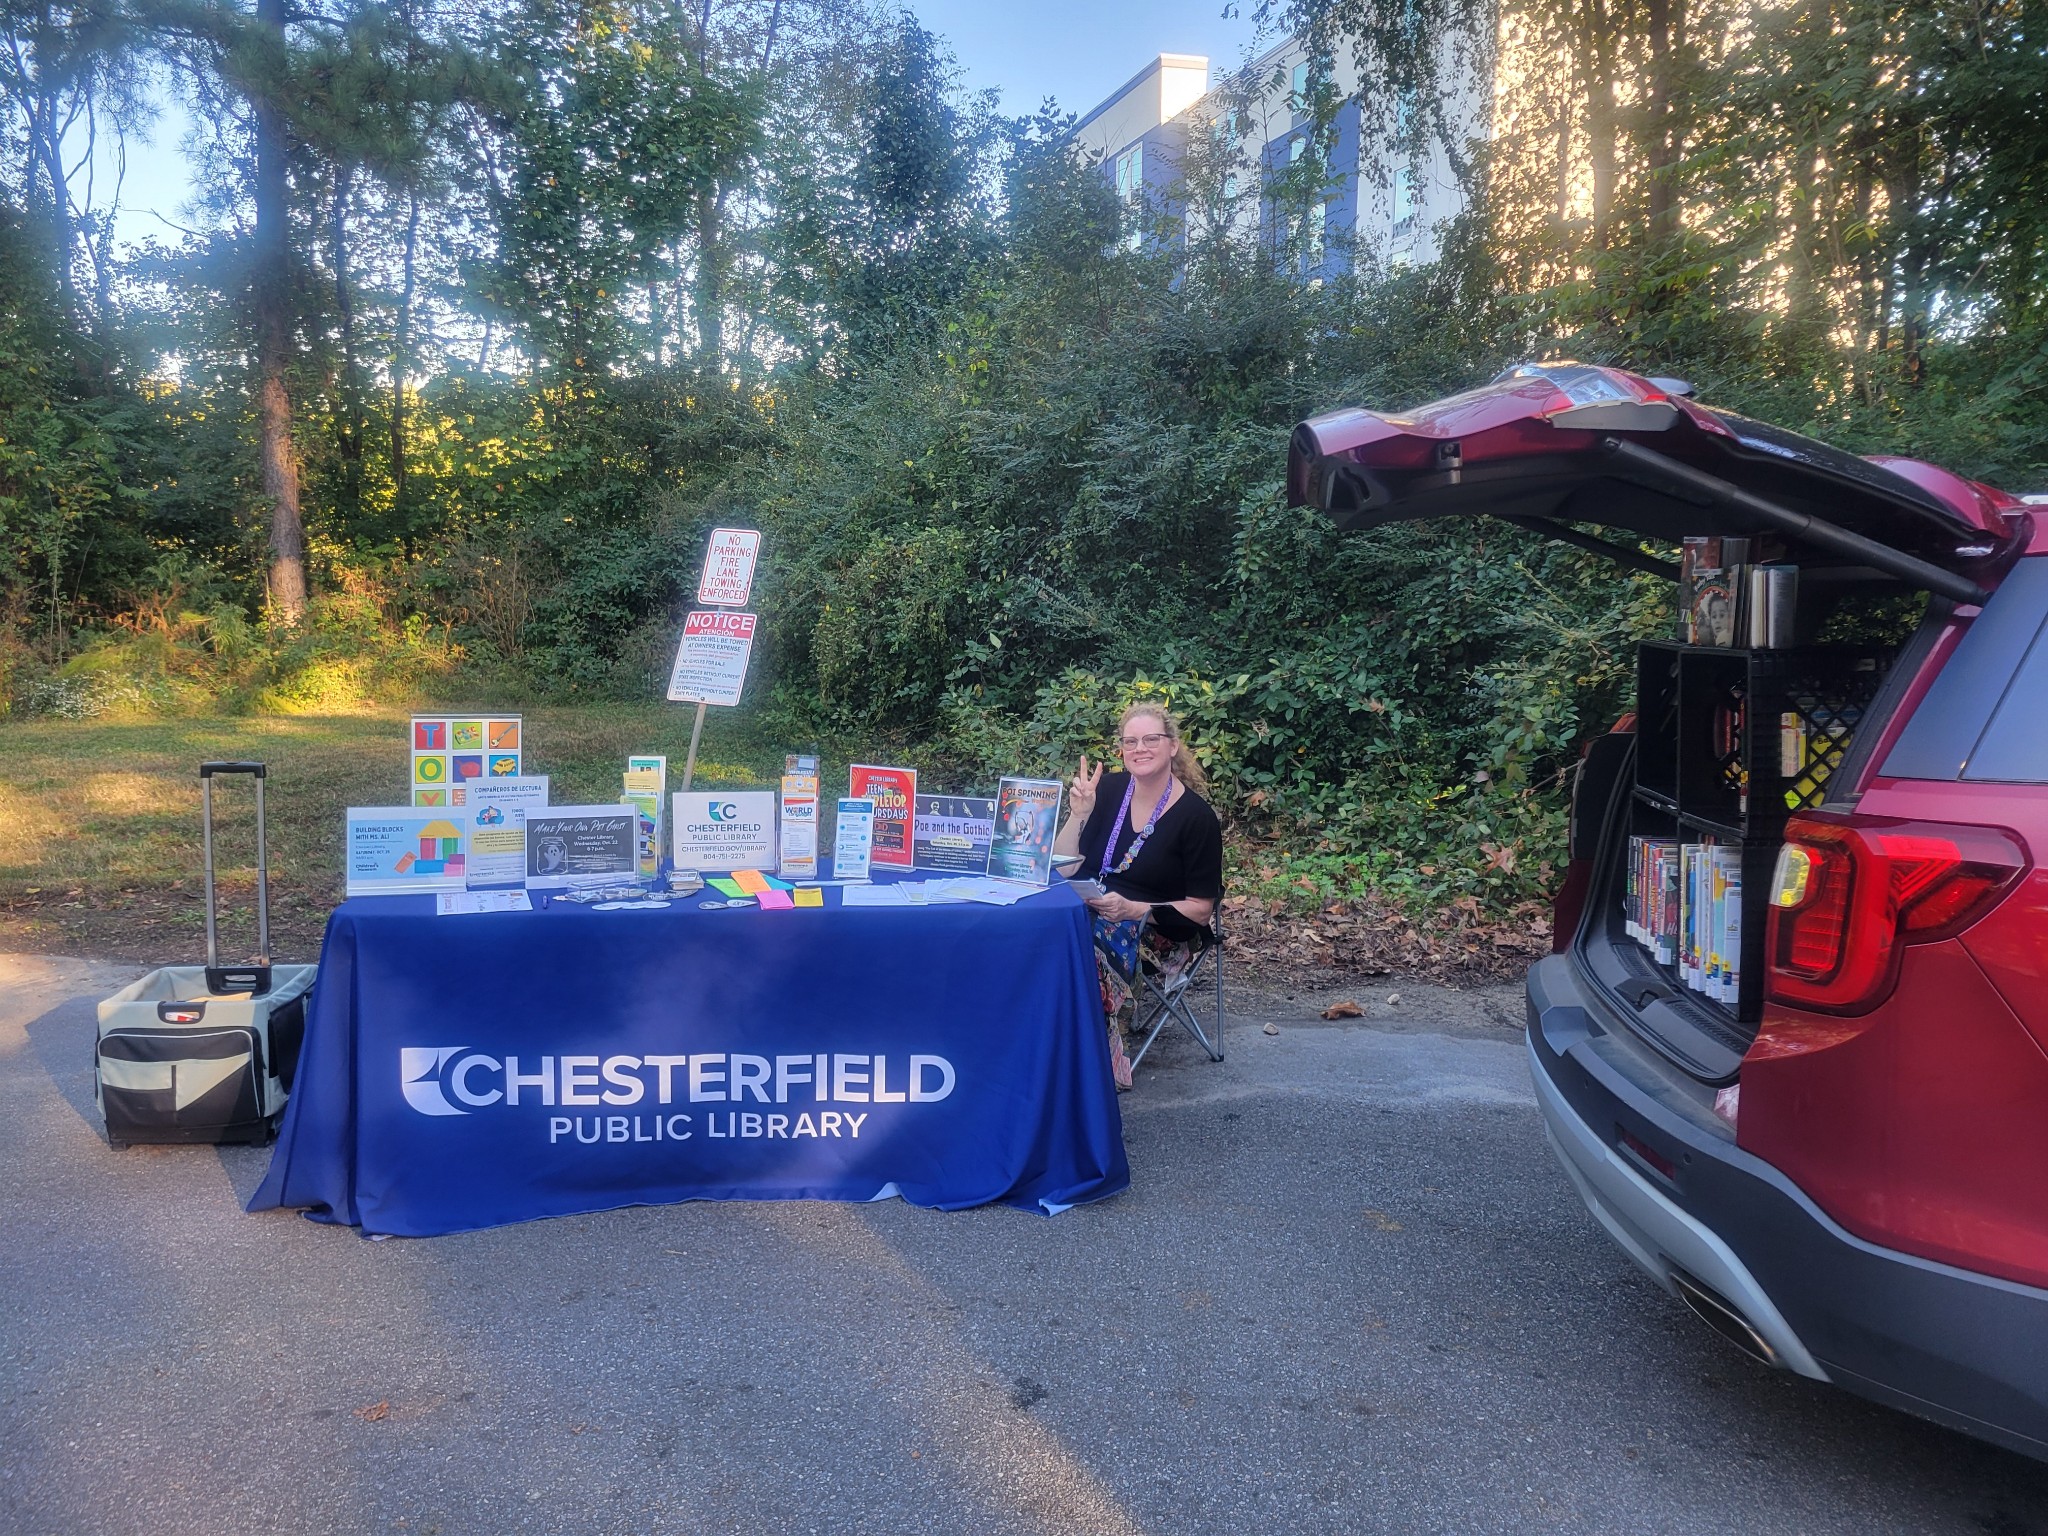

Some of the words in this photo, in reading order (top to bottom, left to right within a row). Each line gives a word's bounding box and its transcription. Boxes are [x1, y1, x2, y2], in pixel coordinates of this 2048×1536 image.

[728, 536, 741, 545] NO
[714, 546, 751, 557] PARKING
[720, 557, 740, 567] FIRE
[716, 567, 739, 578] LANE
[710, 577, 742, 589] TOWING
[702, 587, 745, 600] ENFORCED
[688, 615, 753, 631] NOTICE
[716, 644, 742, 652] EXPENSE
[422, 725, 439, 747] T
[474, 785, 511, 794] COMPAÑEROS
[866, 783, 884, 795] TEEN
[1017, 788, 1058, 800] SPINNING
[686, 823, 761, 833] CHESTERFIELD
[915, 819, 930, 832] Poe
[931, 822, 945, 833] and
[948, 822, 962, 834] the
[963, 822, 990, 836] Gothic
[692, 834, 721, 842] PUBLIC
[723, 833, 757, 841] LIBRARY
[681, 845, 768, 853] CHESTERFIELD.GOV/LIBRARY
[451, 1053, 956, 1106] CHESTERFIELD
[549, 1113, 693, 1144] PUBLIC
[708, 1111, 868, 1139] LIBRARY
